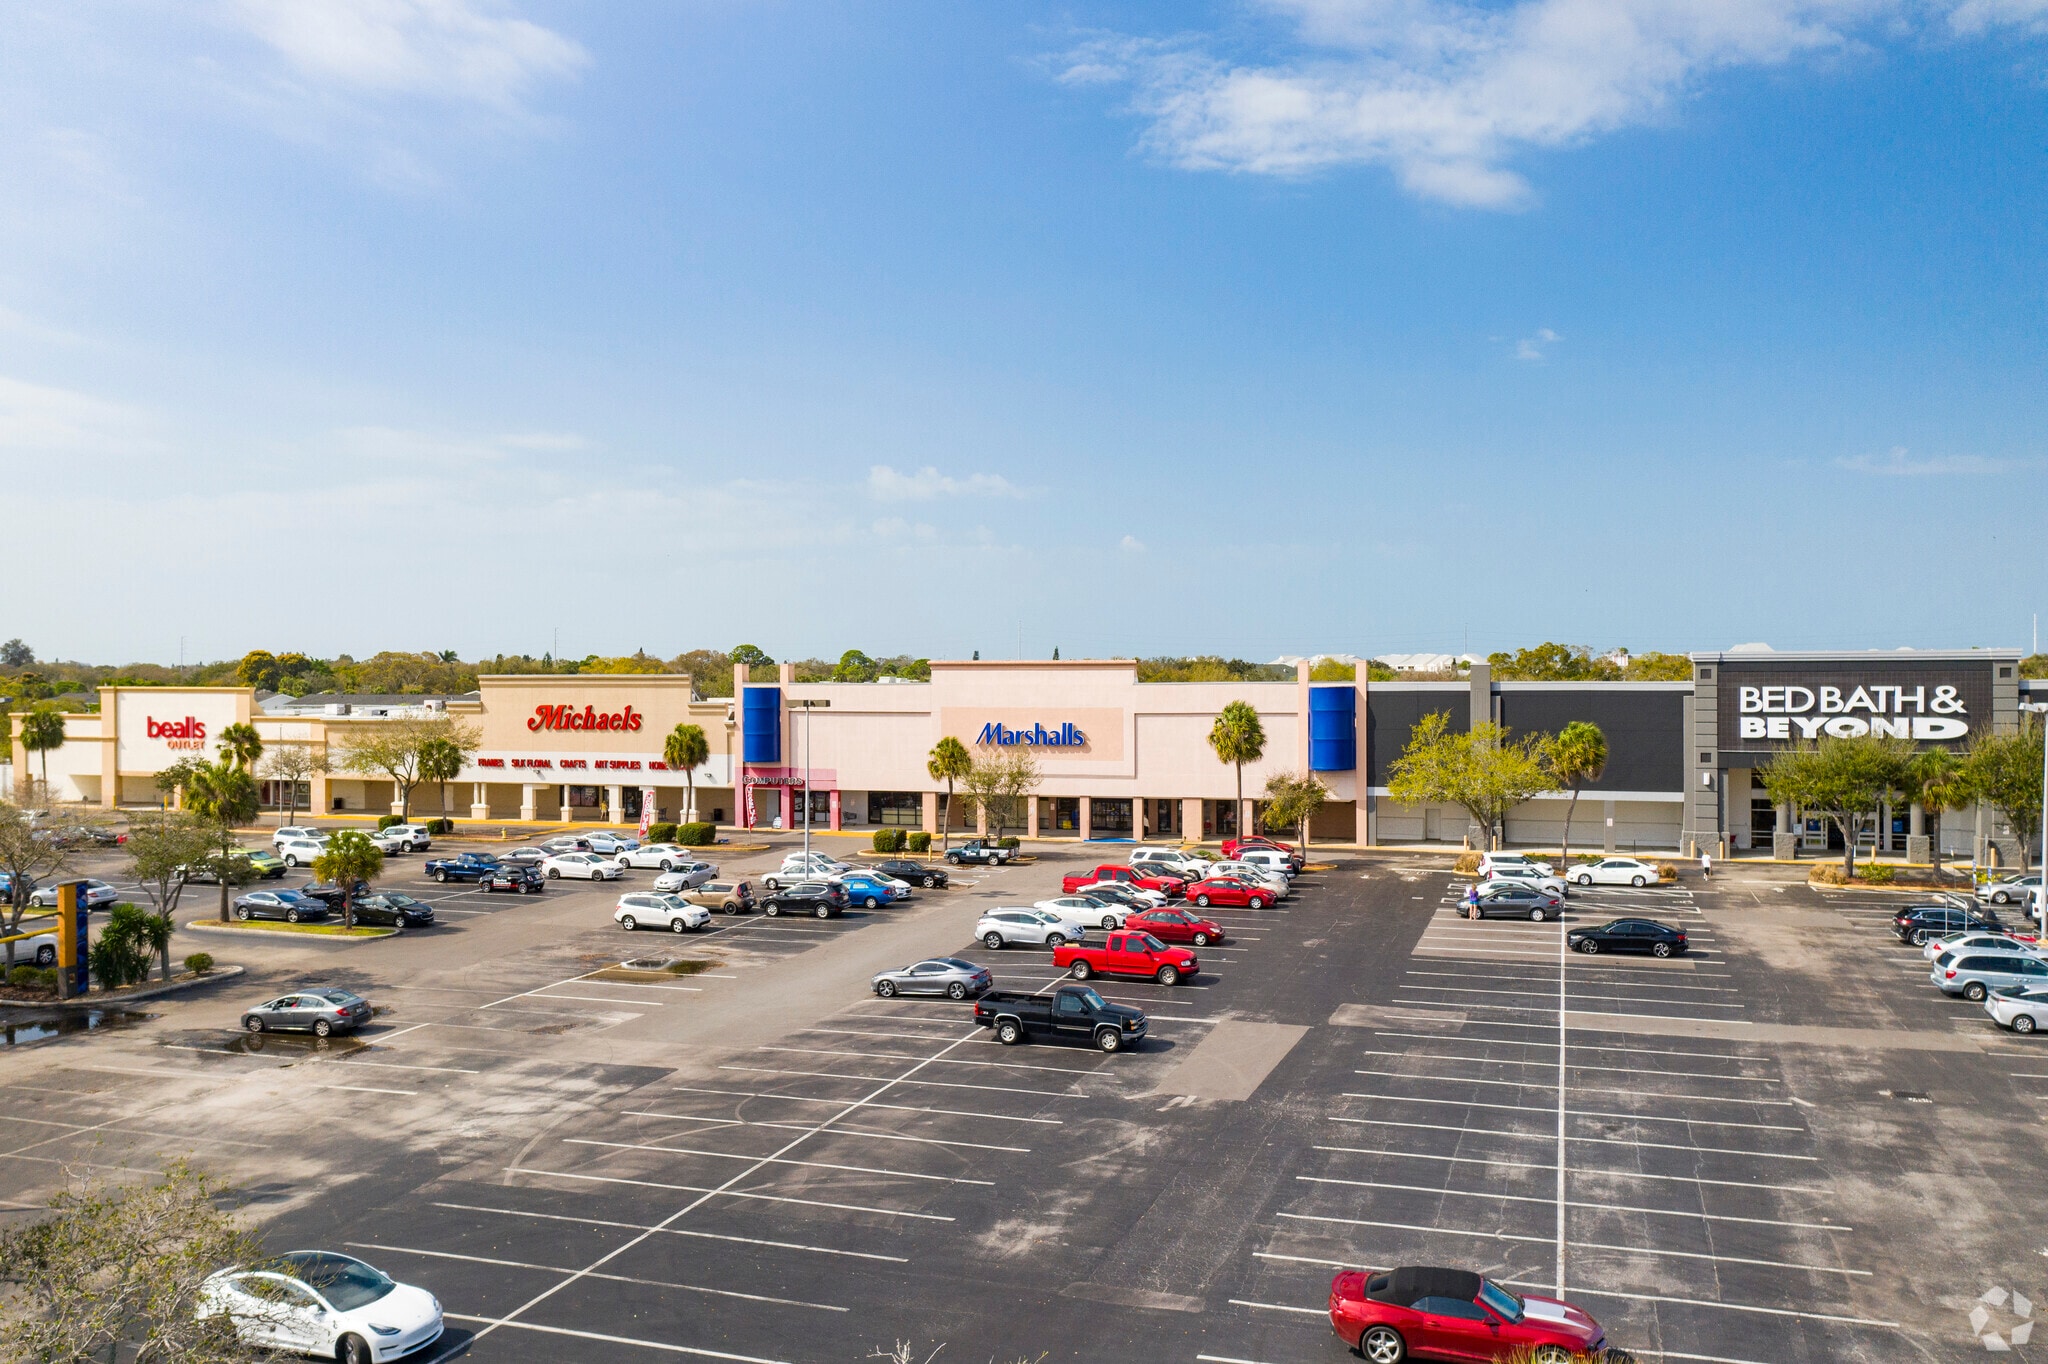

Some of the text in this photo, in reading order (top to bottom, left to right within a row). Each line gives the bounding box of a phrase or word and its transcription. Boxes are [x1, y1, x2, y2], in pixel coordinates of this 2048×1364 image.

[1740, 685, 1967, 713] BED BATH &
[147, 716, 206, 739] bealls
[527, 705, 641, 731] Michaels
[1740, 717, 1969, 739] BEYOND
[167, 740, 205, 750] OUTLET
[976, 722, 1085, 746] Marshalls
[478, 758, 504, 768] FRAMES
[511, 759, 526, 768] SILK
[527, 759, 552, 768] FLORAL
[560, 760, 586, 769] CRAFTS
[595, 760, 608, 769] ART
[609, 760, 641, 770] SUPPLIES
[742, 775, 804, 786] COMPUTERS
